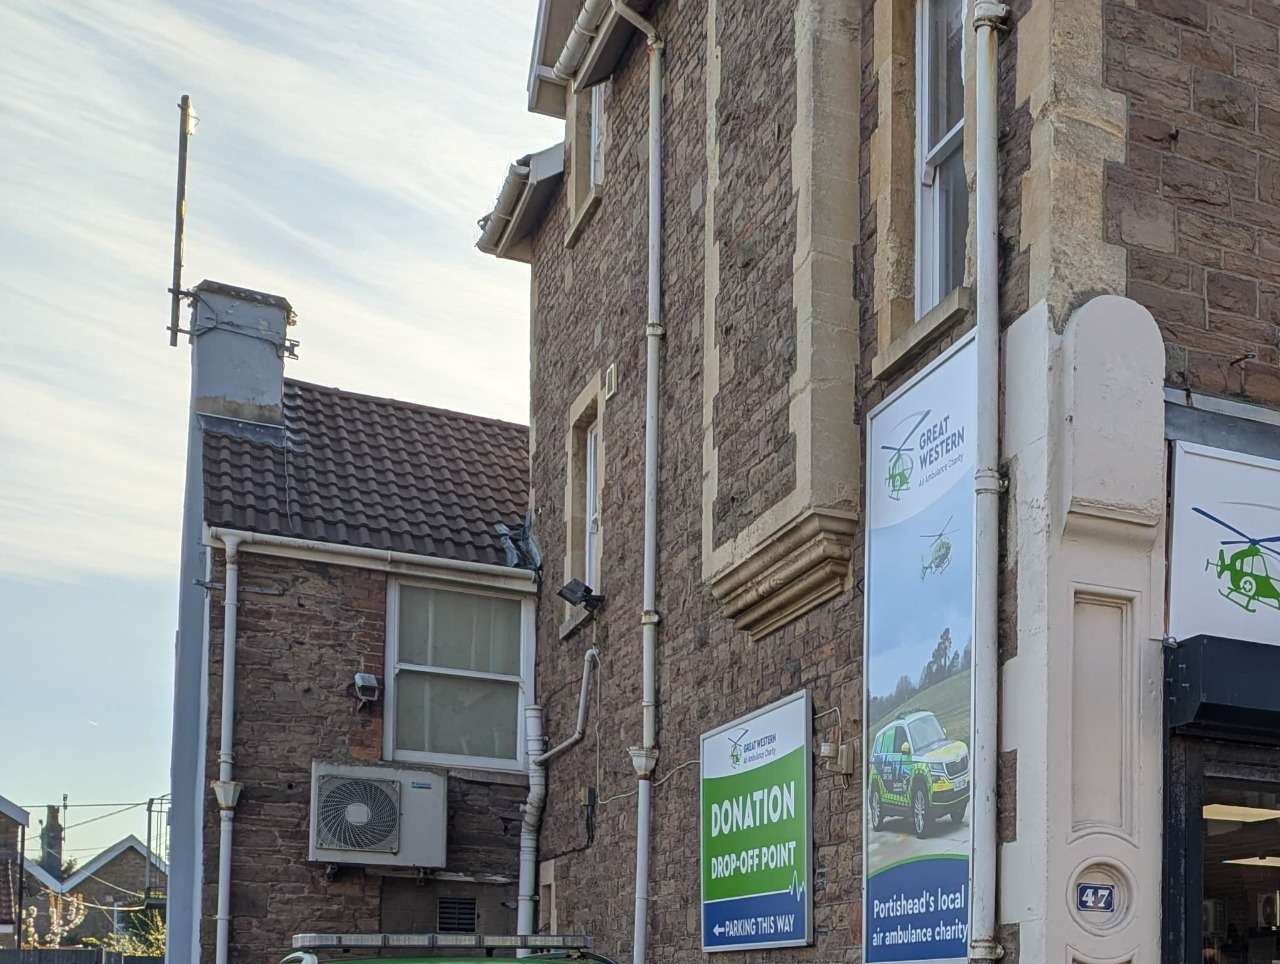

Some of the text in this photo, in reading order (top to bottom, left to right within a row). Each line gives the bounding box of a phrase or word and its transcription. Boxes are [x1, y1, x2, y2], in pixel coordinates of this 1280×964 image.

[919, 416, 950, 450] GREAT
[919, 426, 965, 469] WESTERN
[711, 780, 795, 838] DONATION
[711, 841, 797, 880] DROP-OFF POINT
[873, 884, 965, 919] Portishead's local
[1081, 888, 1111, 907] 47
[725, 913, 796, 937] PARKING THIS WAY
[872, 918, 968, 946] air ambulance charity
